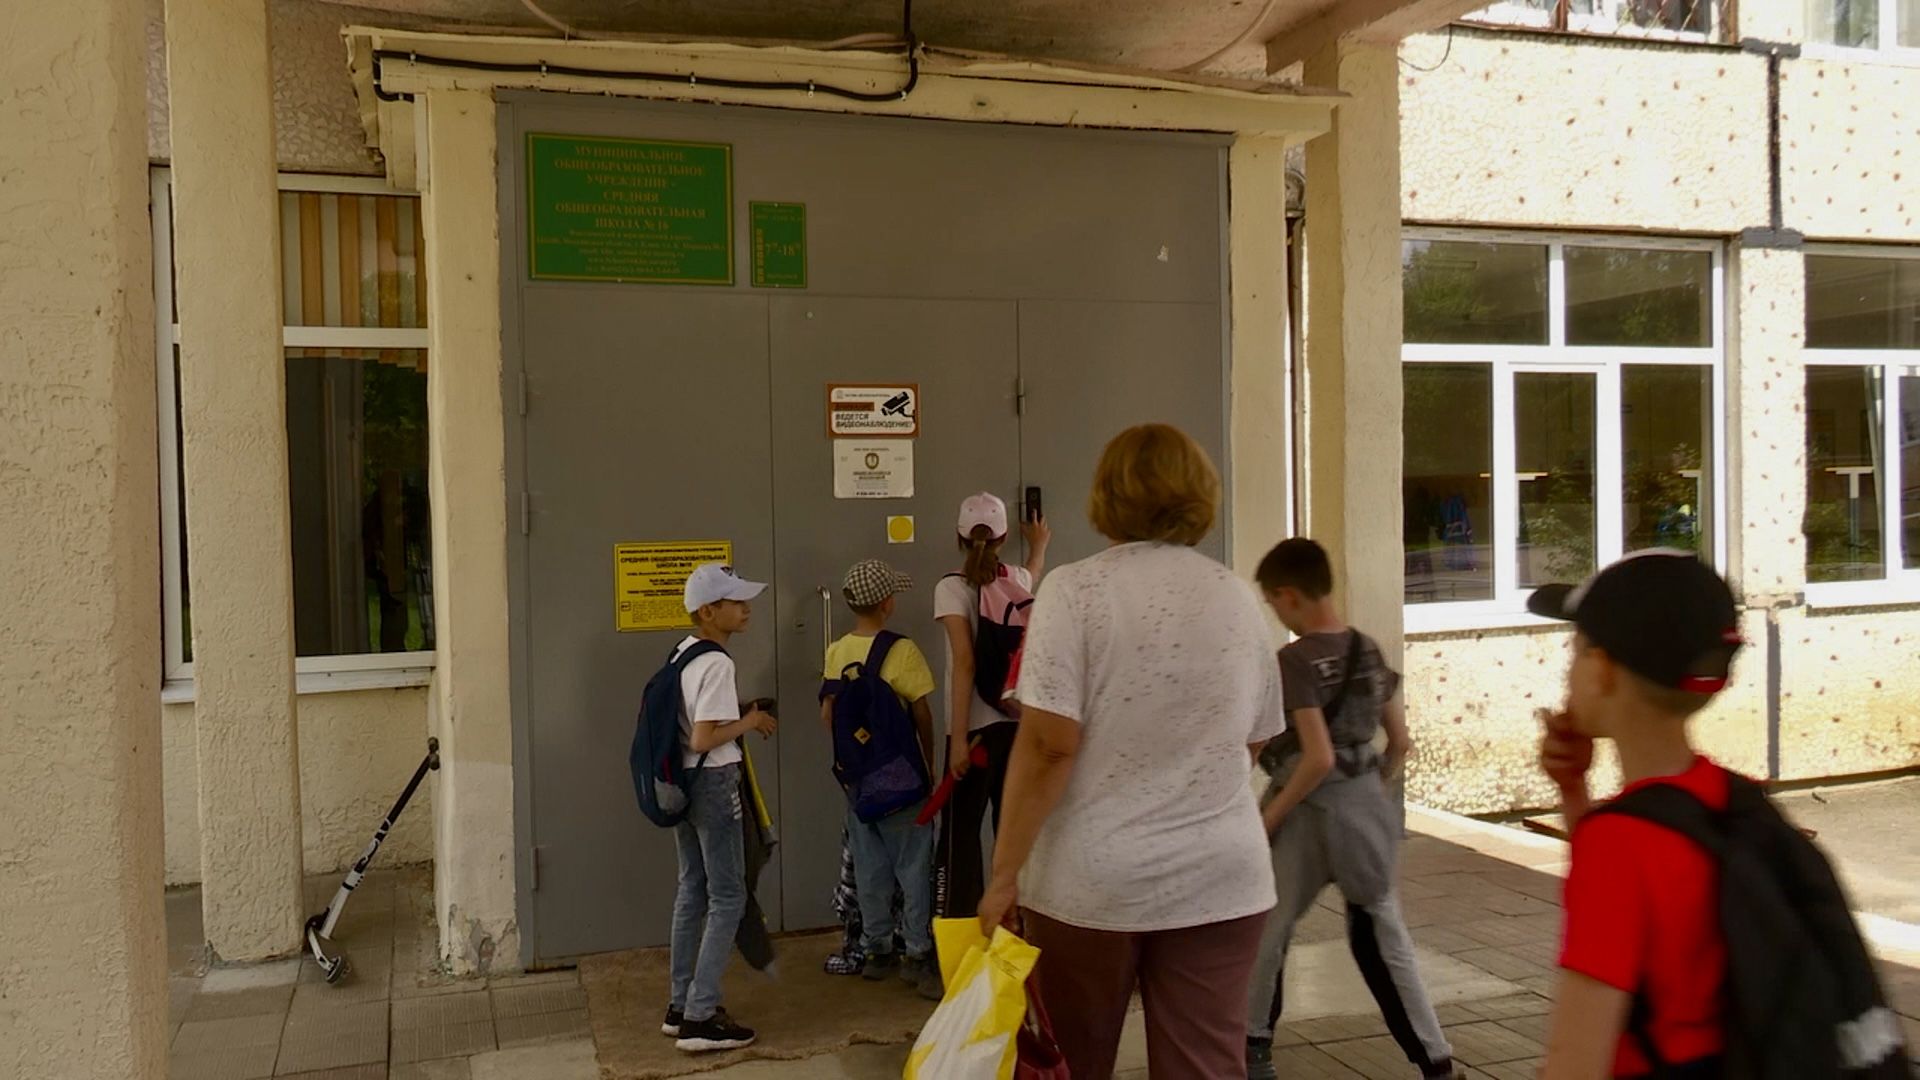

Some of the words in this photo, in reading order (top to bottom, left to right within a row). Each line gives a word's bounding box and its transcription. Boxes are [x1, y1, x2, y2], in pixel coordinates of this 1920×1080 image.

[575, 145, 686, 161] МУНИЦИПАЛЬНОЕ
[554, 158, 705, 176] ОБЩЕОБРАЗОВАТЕЛЬНОЕ
[587, 174, 669, 188] УЧРЕЖДЕНИЕ
[603, 191, 660, 202] СРЕДНЯЯ
[555, 202, 706, 219] ОБЩЕОБРАЗОВАТЕЛЬНАЯ
[595, 218, 641, 229] ШКОЛА
[620, 556, 649, 564] СРЕДНЯЯ
[650, 555, 726, 563] ОБЩЕОБРАЗОВАТЕЛЬНАЯ
